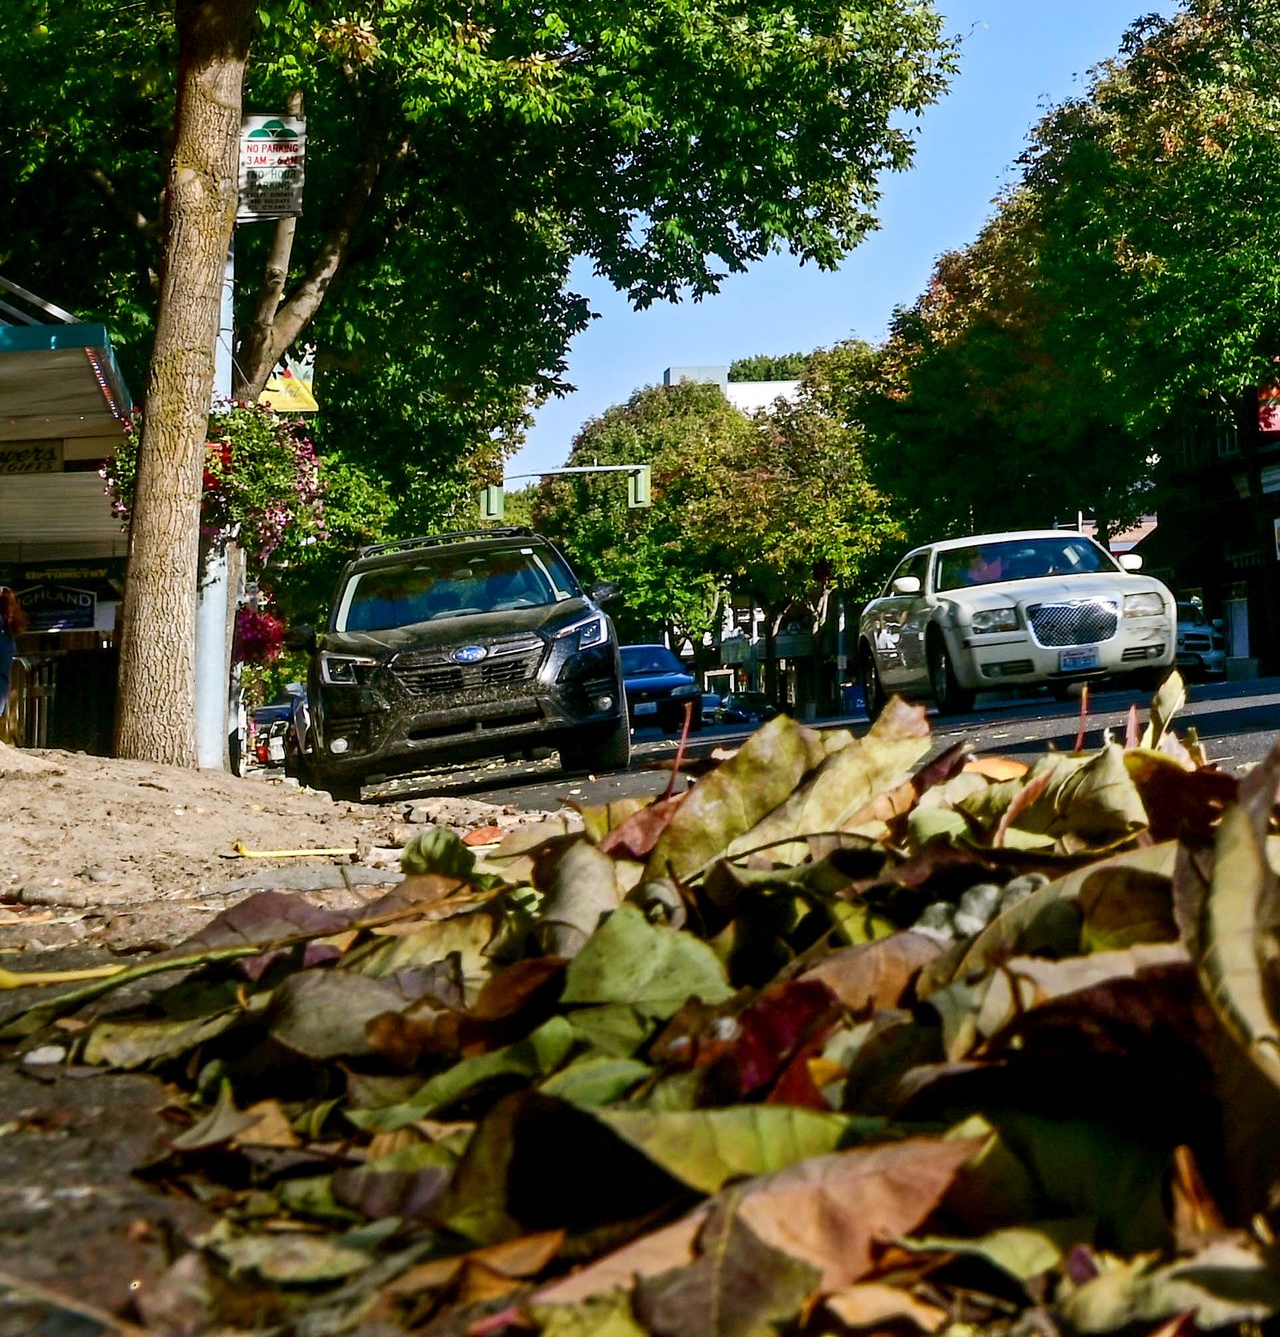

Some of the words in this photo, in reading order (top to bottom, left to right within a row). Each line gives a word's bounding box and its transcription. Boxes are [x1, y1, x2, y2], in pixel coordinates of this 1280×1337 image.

[246, 144, 259, 153] NO
[262, 143, 298, 153] PARKING
[247, 156, 253, 165] 3
[254, 156, 267, 165] AM
[271, 169, 296, 179] HOUR
[250, 181, 290, 190] PARKING
[17, 589, 92, 607] IGHLAND
